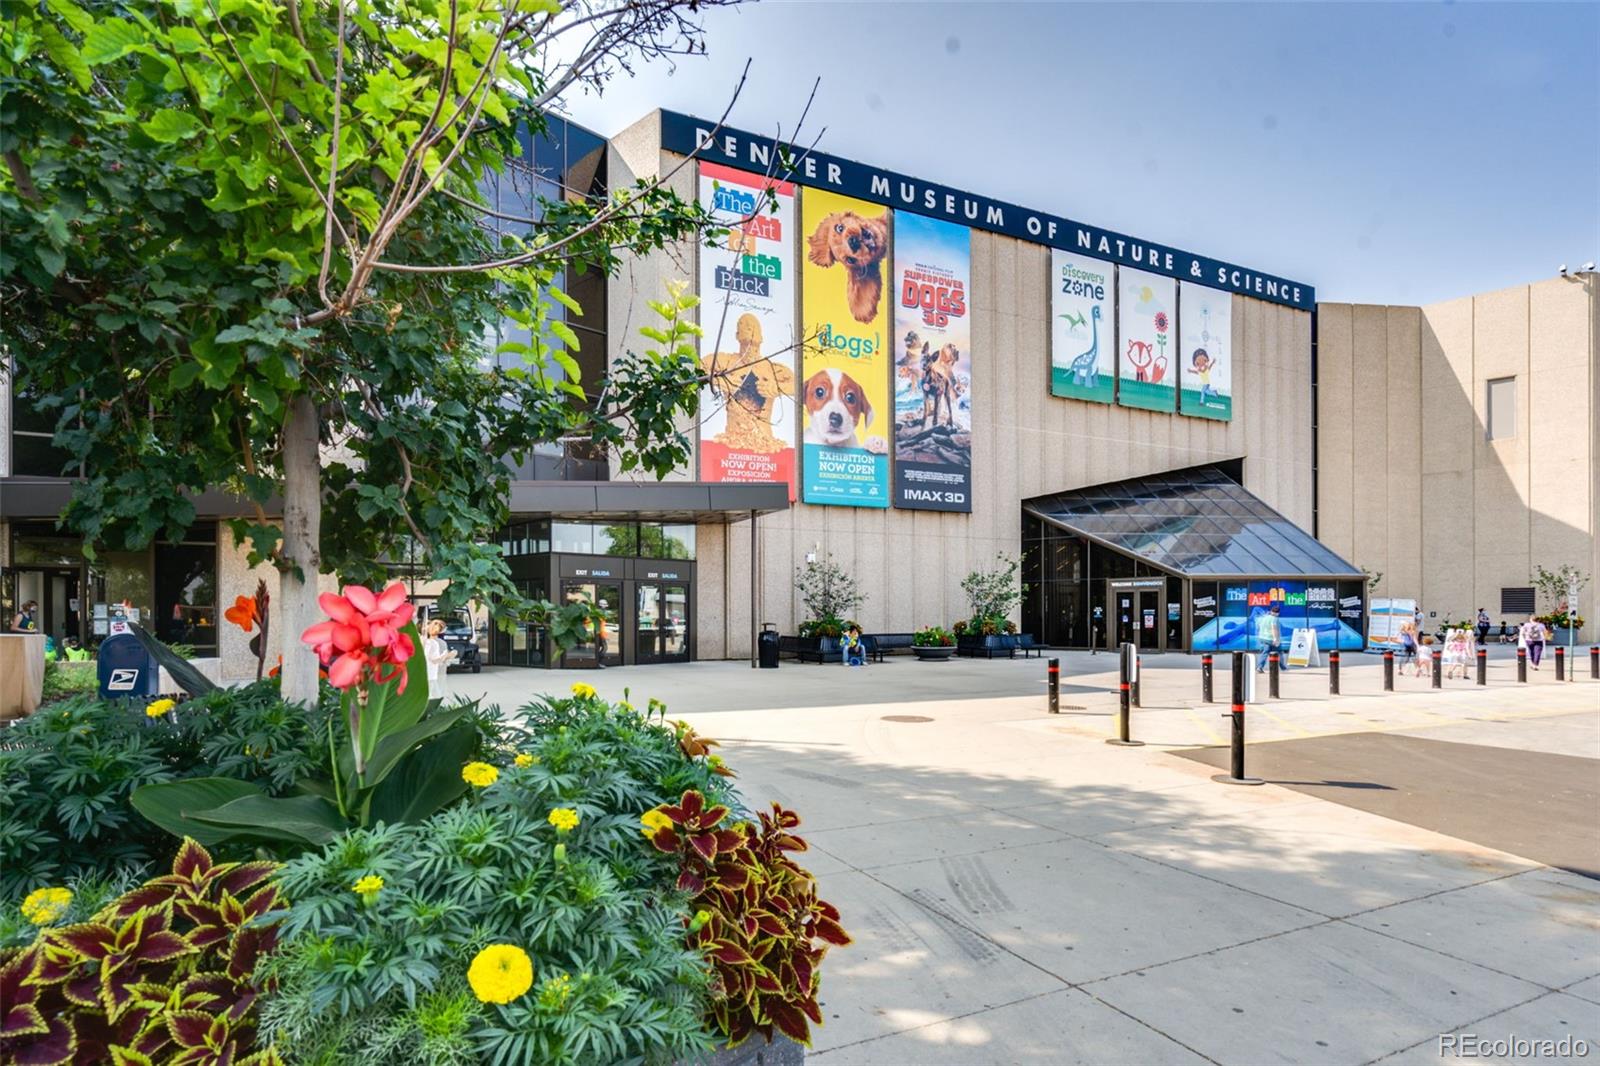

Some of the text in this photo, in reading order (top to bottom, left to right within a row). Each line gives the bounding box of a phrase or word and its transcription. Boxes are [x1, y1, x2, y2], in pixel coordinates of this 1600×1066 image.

[718, 191, 752, 214] The
[696, 127, 1301, 302] DENVER MUSEUM OF NATURE & SCIENCE
[749, 220, 775, 239] Art
[749, 257, 776, 278] the
[720, 271, 764, 295] Brick
[904, 270, 964, 289] SUPERPOWER
[902, 280, 965, 317] DOGS
[922, 309, 948, 327] 3D
[721, 459, 777, 472] NOW OPEN!
[819, 451, 875, 464] EXHIBITION
[819, 461, 875, 475] NOW OPEN
[904, 489, 965, 503] IMAX 3D
[1229, 590, 1247, 601] The
[1252, 594, 1267, 605] Art
[1288, 595, 1303, 605] the
